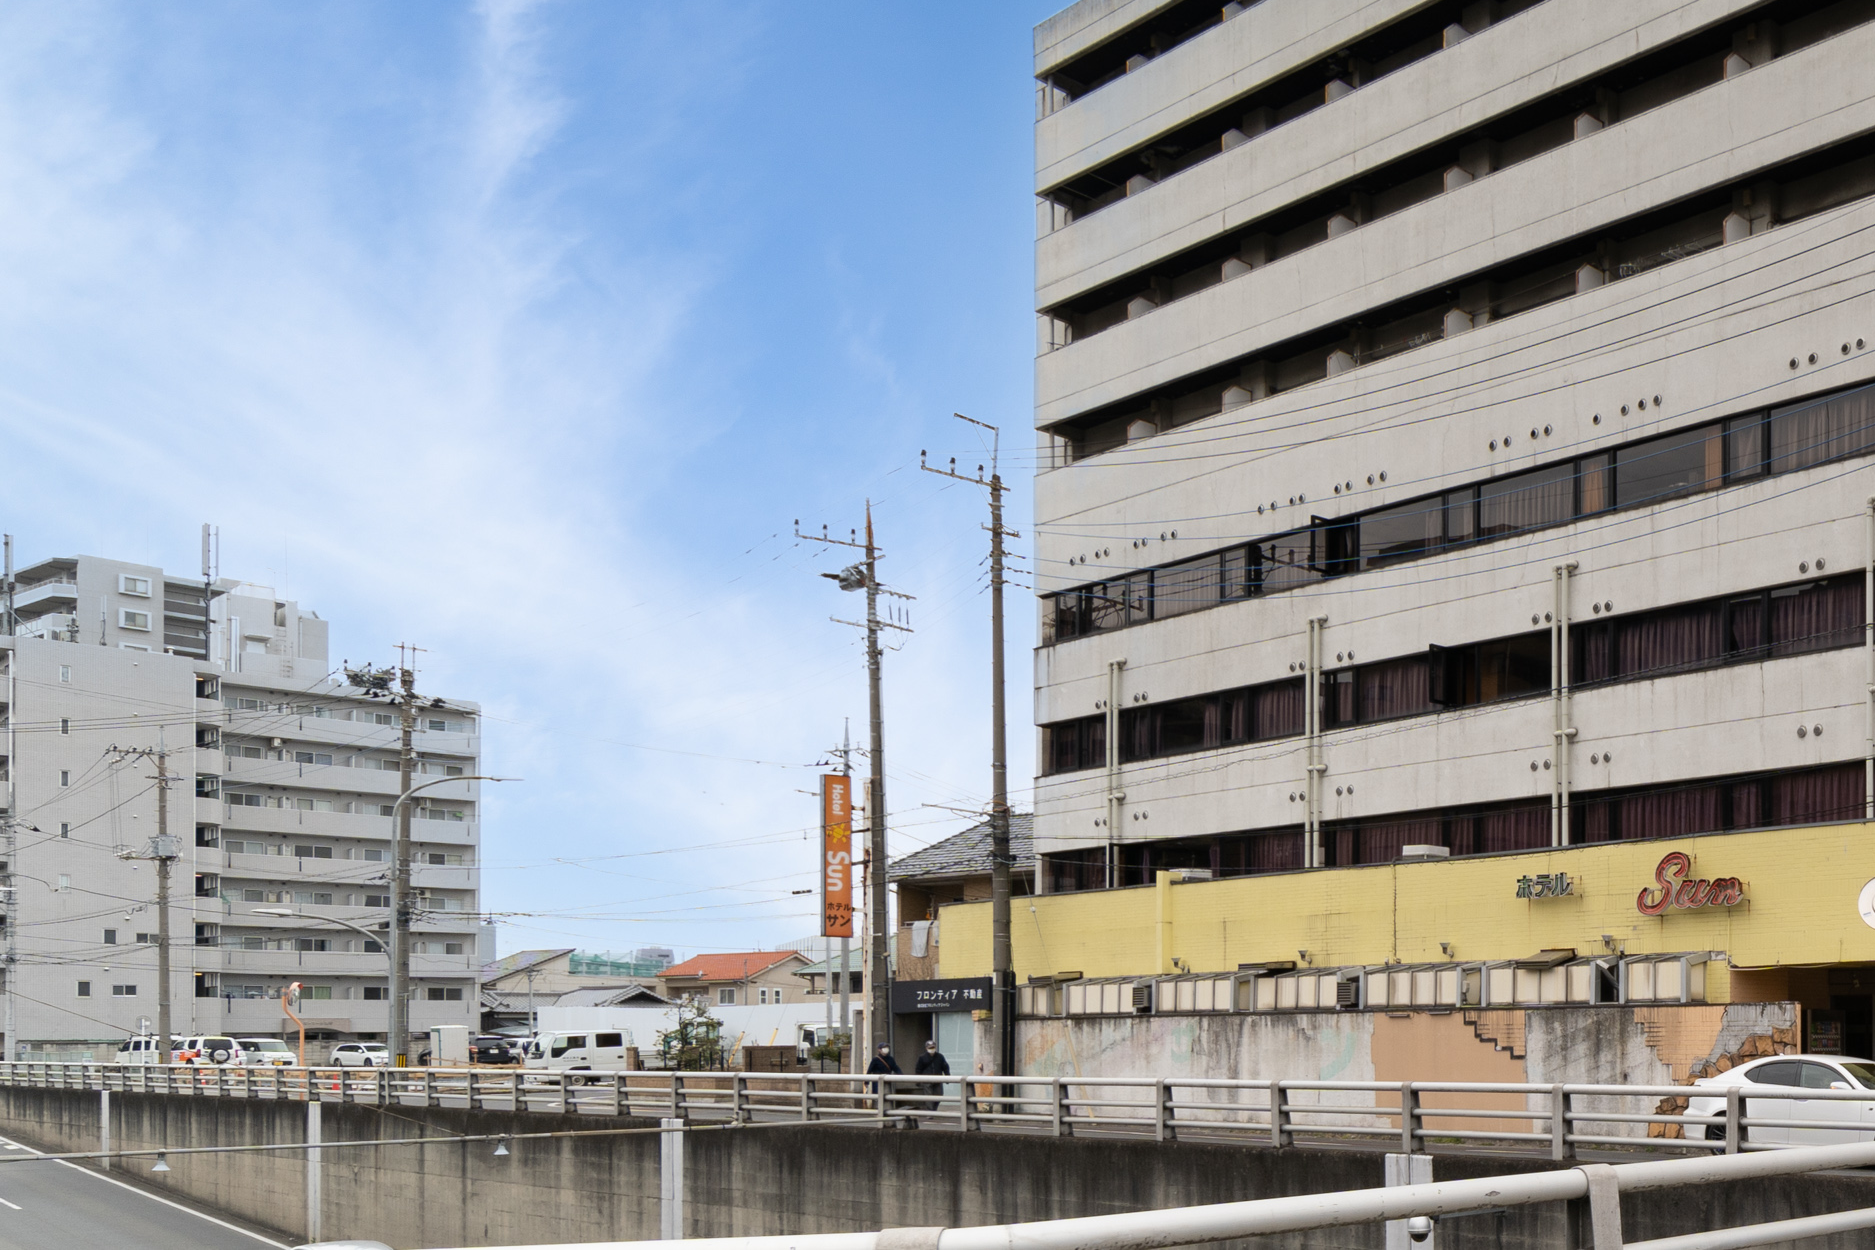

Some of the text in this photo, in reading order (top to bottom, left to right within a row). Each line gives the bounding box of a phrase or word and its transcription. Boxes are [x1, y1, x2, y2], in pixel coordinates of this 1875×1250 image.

[827, 783, 850, 892] Hotel Sun
[1516, 871, 1574, 899] ホテル
[1637, 851, 1744, 916] Sun
[827, 902, 851, 912] ホテル
[826, 913, 851, 928] サン
[916, 988, 983, 1001] フロンティア 不動産
